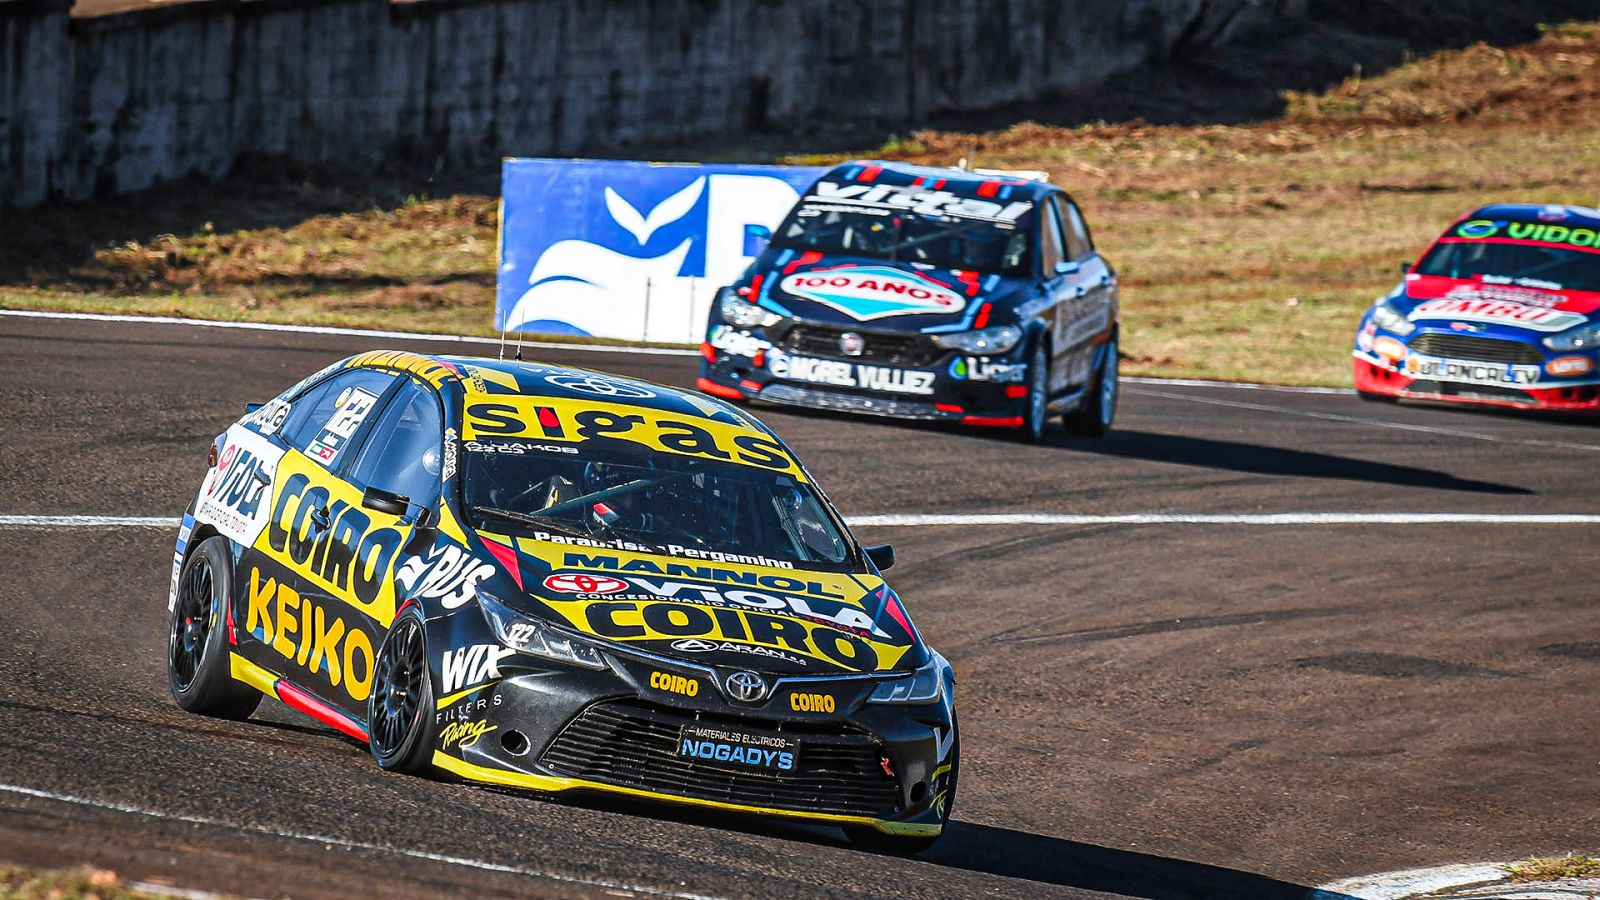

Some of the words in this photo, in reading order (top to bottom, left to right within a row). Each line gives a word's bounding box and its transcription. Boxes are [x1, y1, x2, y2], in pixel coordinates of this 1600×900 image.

[466, 402, 792, 469] sigas
[268, 473, 402, 606] COIRO
[563, 553, 835, 597] MANNOL
[576, 593, 725, 607] CONCESIONARIO
[731, 602, 801, 618] OFICIAL
[246, 566, 375, 701] KEIKO
[507, 623, 536, 642] 122
[585, 602, 880, 672] COIRO
[442, 644, 517, 694] WIX
[650, 671, 699, 697] COIRO
[436, 694, 503, 725] FILTERS
[790, 692, 835, 714] COIRO
[695, 727, 741, 743] MATERIALES
[681, 738, 793, 770] NOGADY'S
